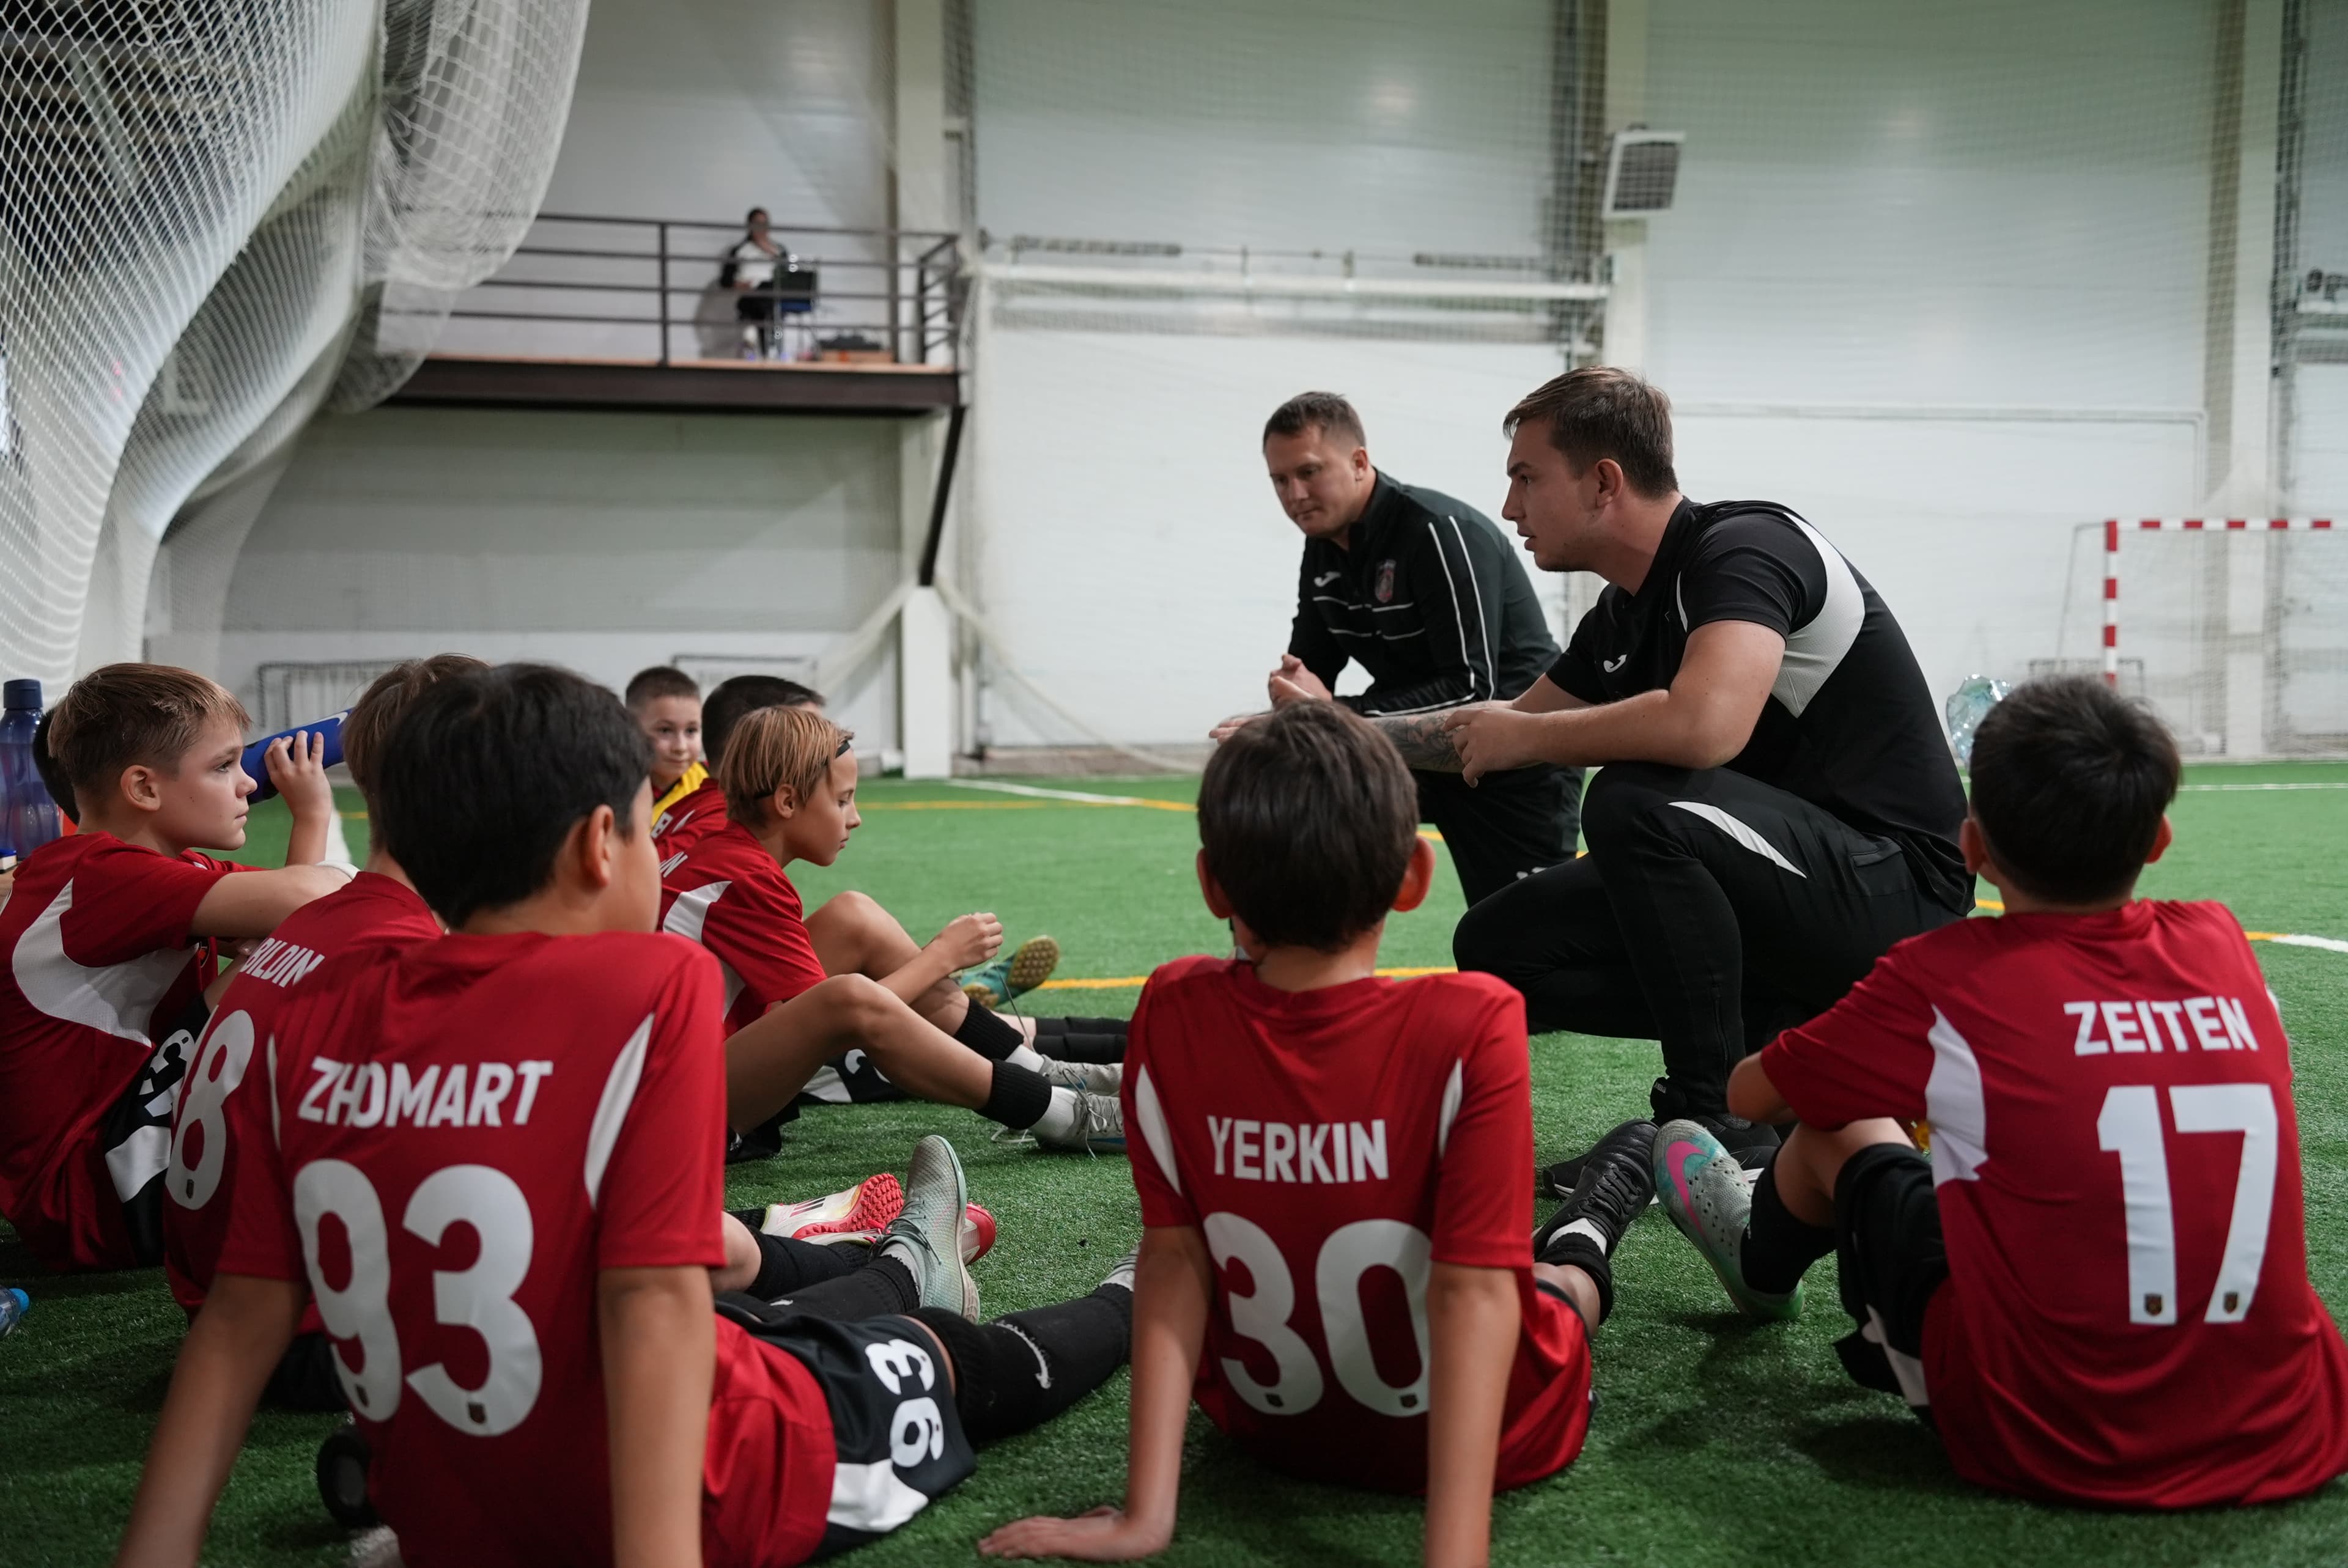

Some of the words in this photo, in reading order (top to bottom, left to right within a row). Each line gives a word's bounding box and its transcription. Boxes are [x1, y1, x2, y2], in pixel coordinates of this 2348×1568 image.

[298, 1056, 553, 1128] ZHOMART
[2064, 997, 2259, 1056] ZEITEN
[1207, 1115, 1389, 1183] YERKIN
[2097, 1084, 2278, 1325] 17
[294, 1158, 542, 1437] 93
[1203, 1212, 1431, 1417] 30
